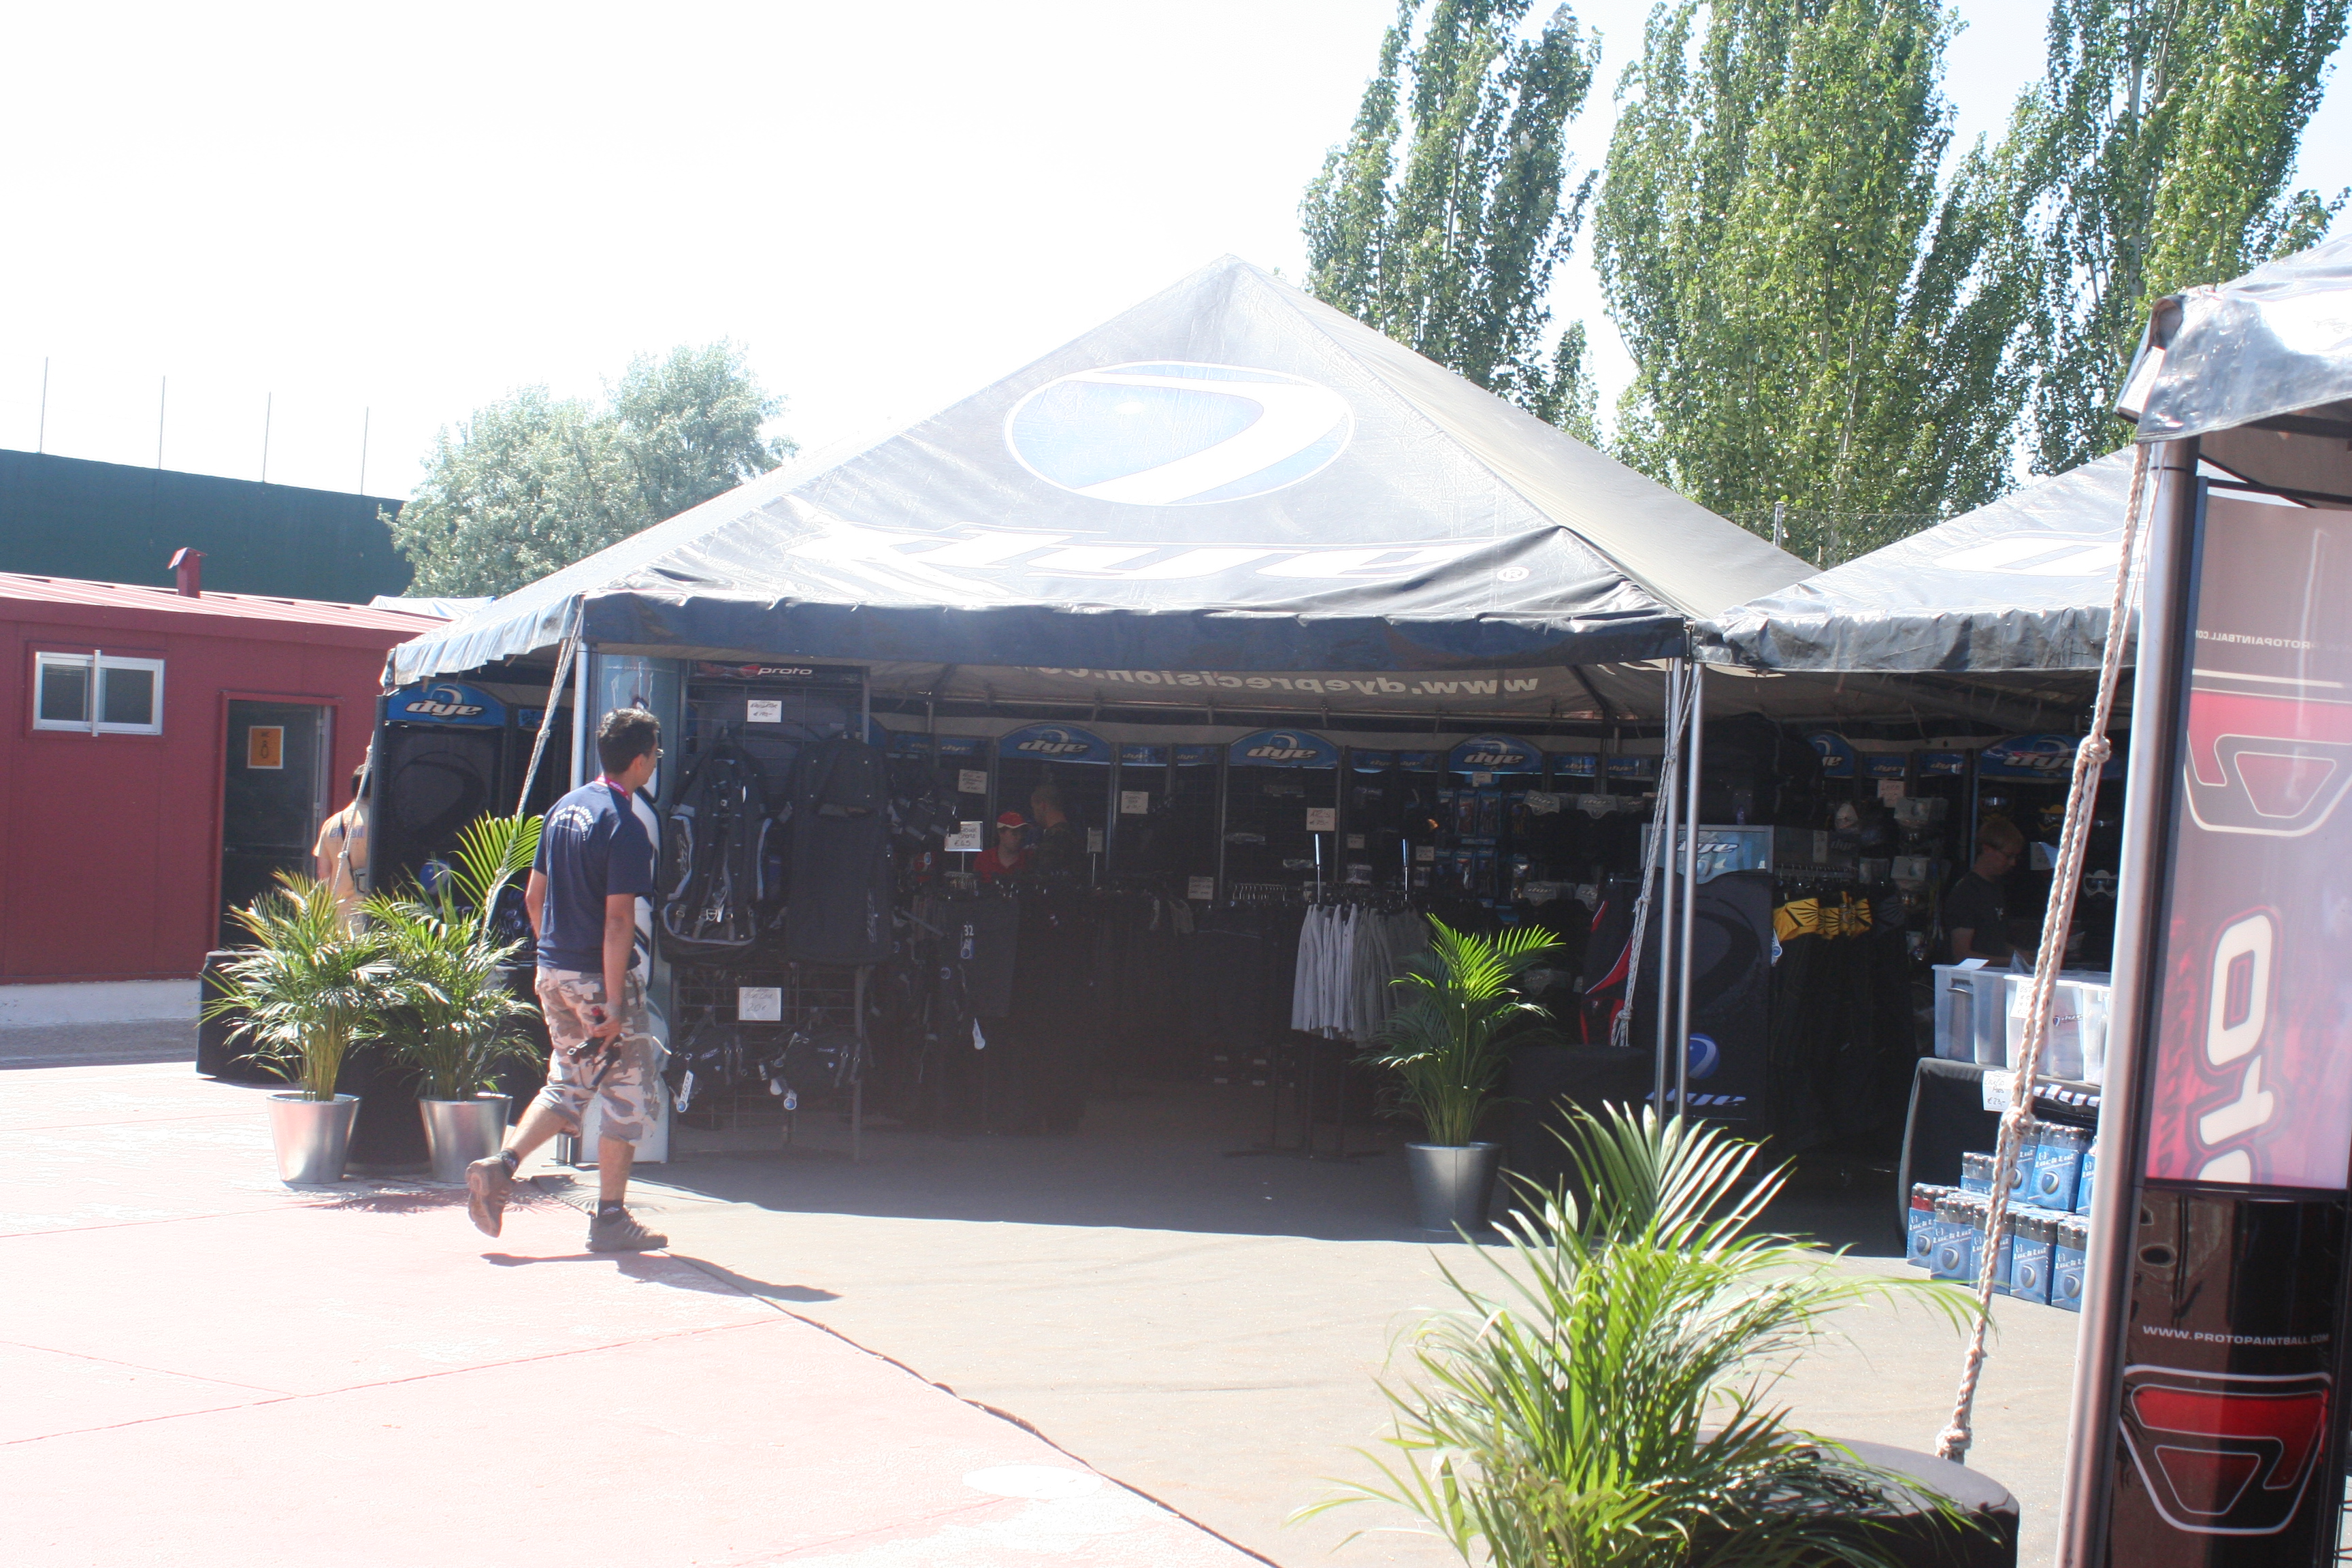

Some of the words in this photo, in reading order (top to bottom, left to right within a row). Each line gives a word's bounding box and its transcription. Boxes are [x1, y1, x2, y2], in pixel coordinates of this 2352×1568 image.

[757, 667, 813, 675] proto
[406, 700, 484, 716] dye
[1017, 739, 1089, 754] dye
[1246, 746, 1318, 760] dye
[1464, 751, 1524, 766] dye
[580, 806, 594, 825] LOVE
[964, 925, 975, 936] 32
[2143, 1325, 2329, 1345] WWW.PROTOPAINTBALL.COM
